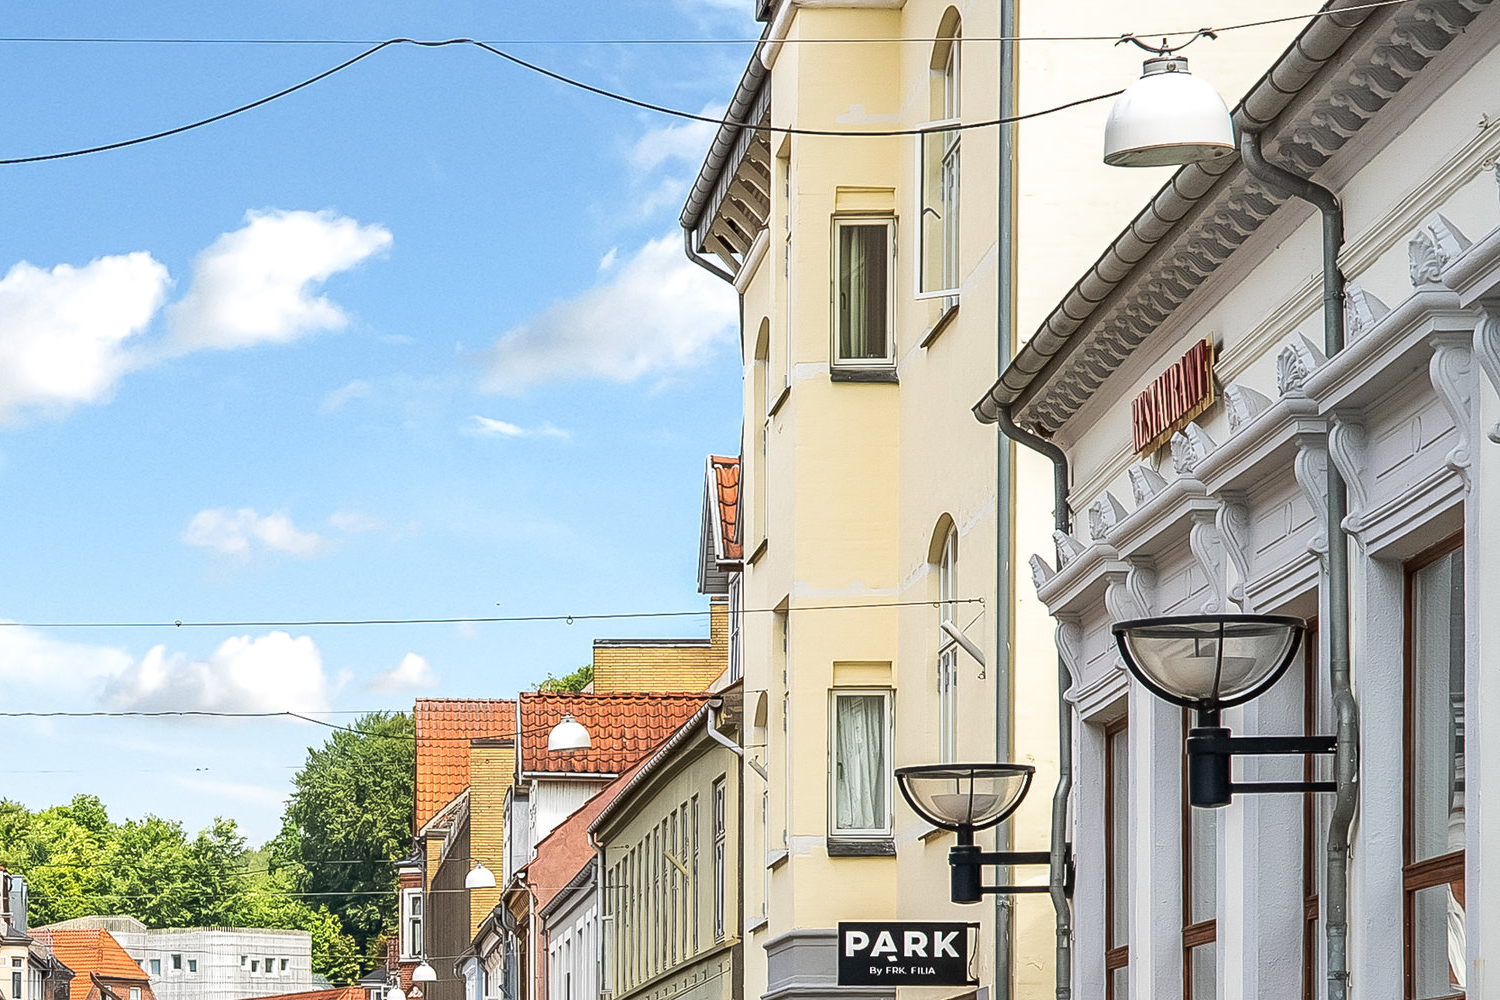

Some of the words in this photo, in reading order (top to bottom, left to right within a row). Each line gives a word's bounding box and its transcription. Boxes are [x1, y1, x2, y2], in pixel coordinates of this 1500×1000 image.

[845, 930, 960, 961] PARK
[870, 966, 882, 976] By
[886, 966, 907, 974] FRK.
[910, 966, 936, 974] FILIA
